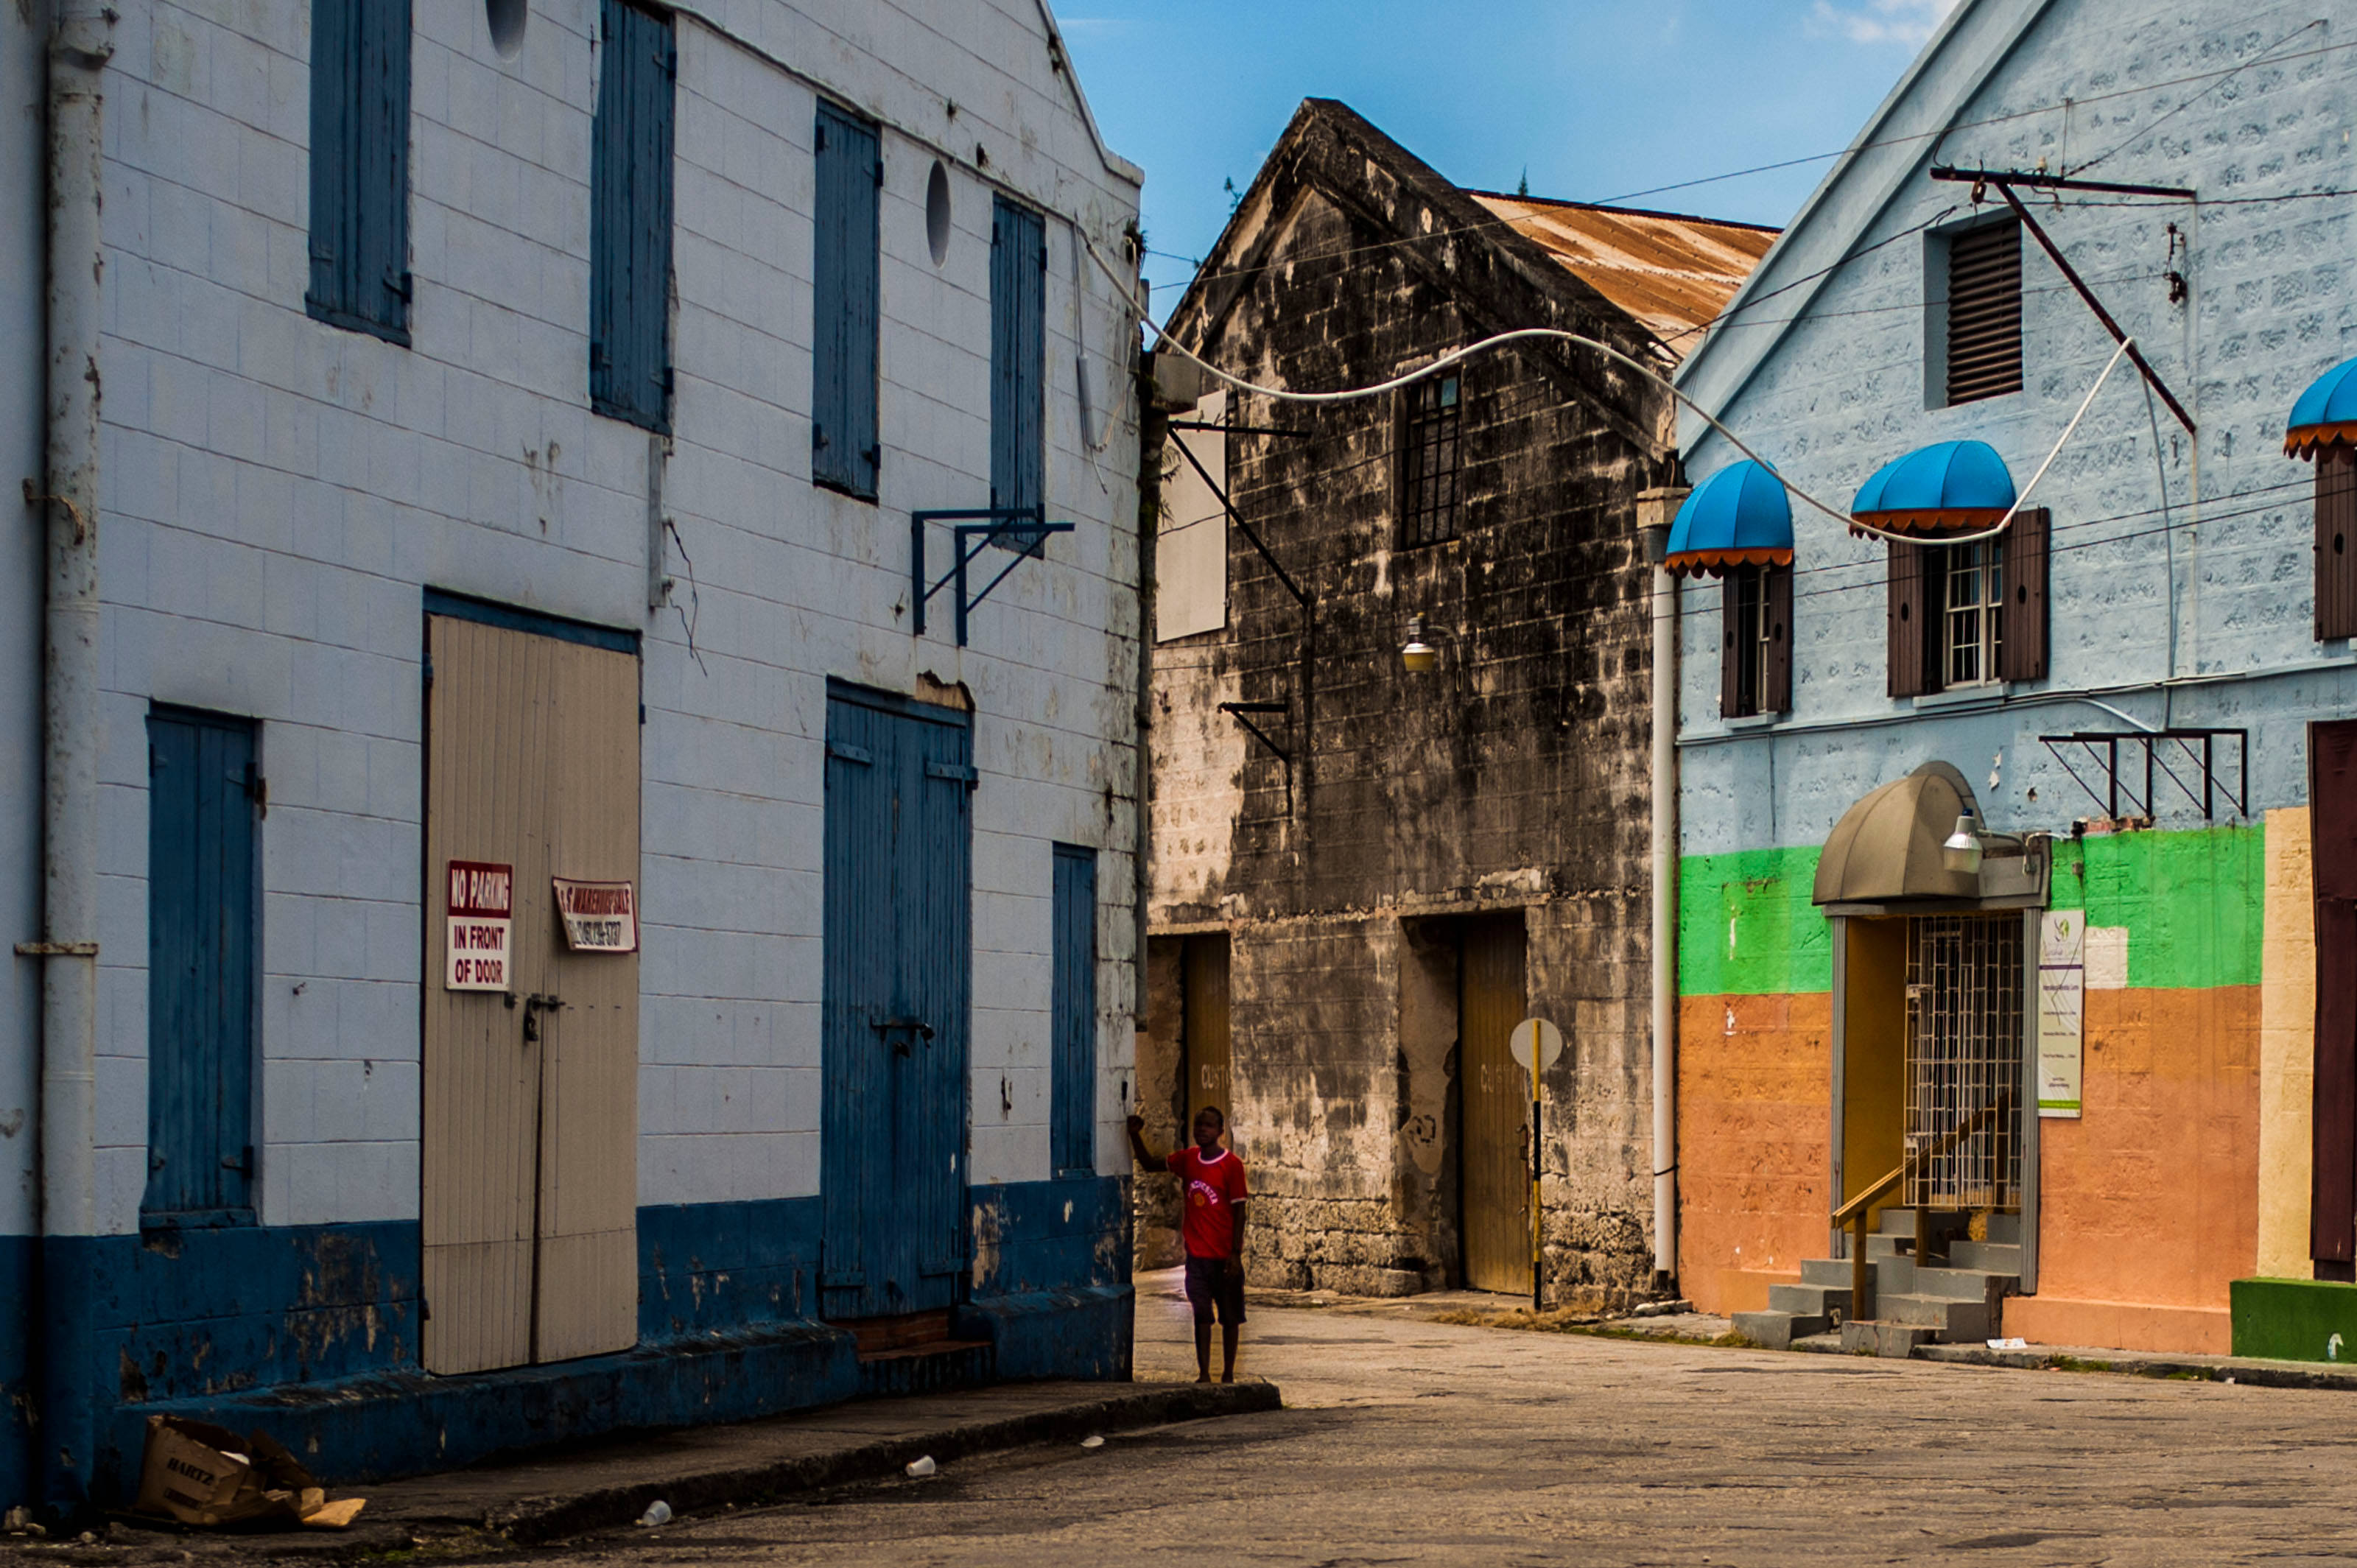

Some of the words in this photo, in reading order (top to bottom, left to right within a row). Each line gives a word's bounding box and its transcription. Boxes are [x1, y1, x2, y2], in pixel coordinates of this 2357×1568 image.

[452, 868, 466, 908] NO
[470, 869, 509, 910] PARKING
[454, 925, 466, 949] IN
[470, 925, 505, 950] FRONT
[454, 959, 471, 983] OF
[475, 959, 502, 984] DOOR
[166, 1457, 214, 1486] HARTZ
